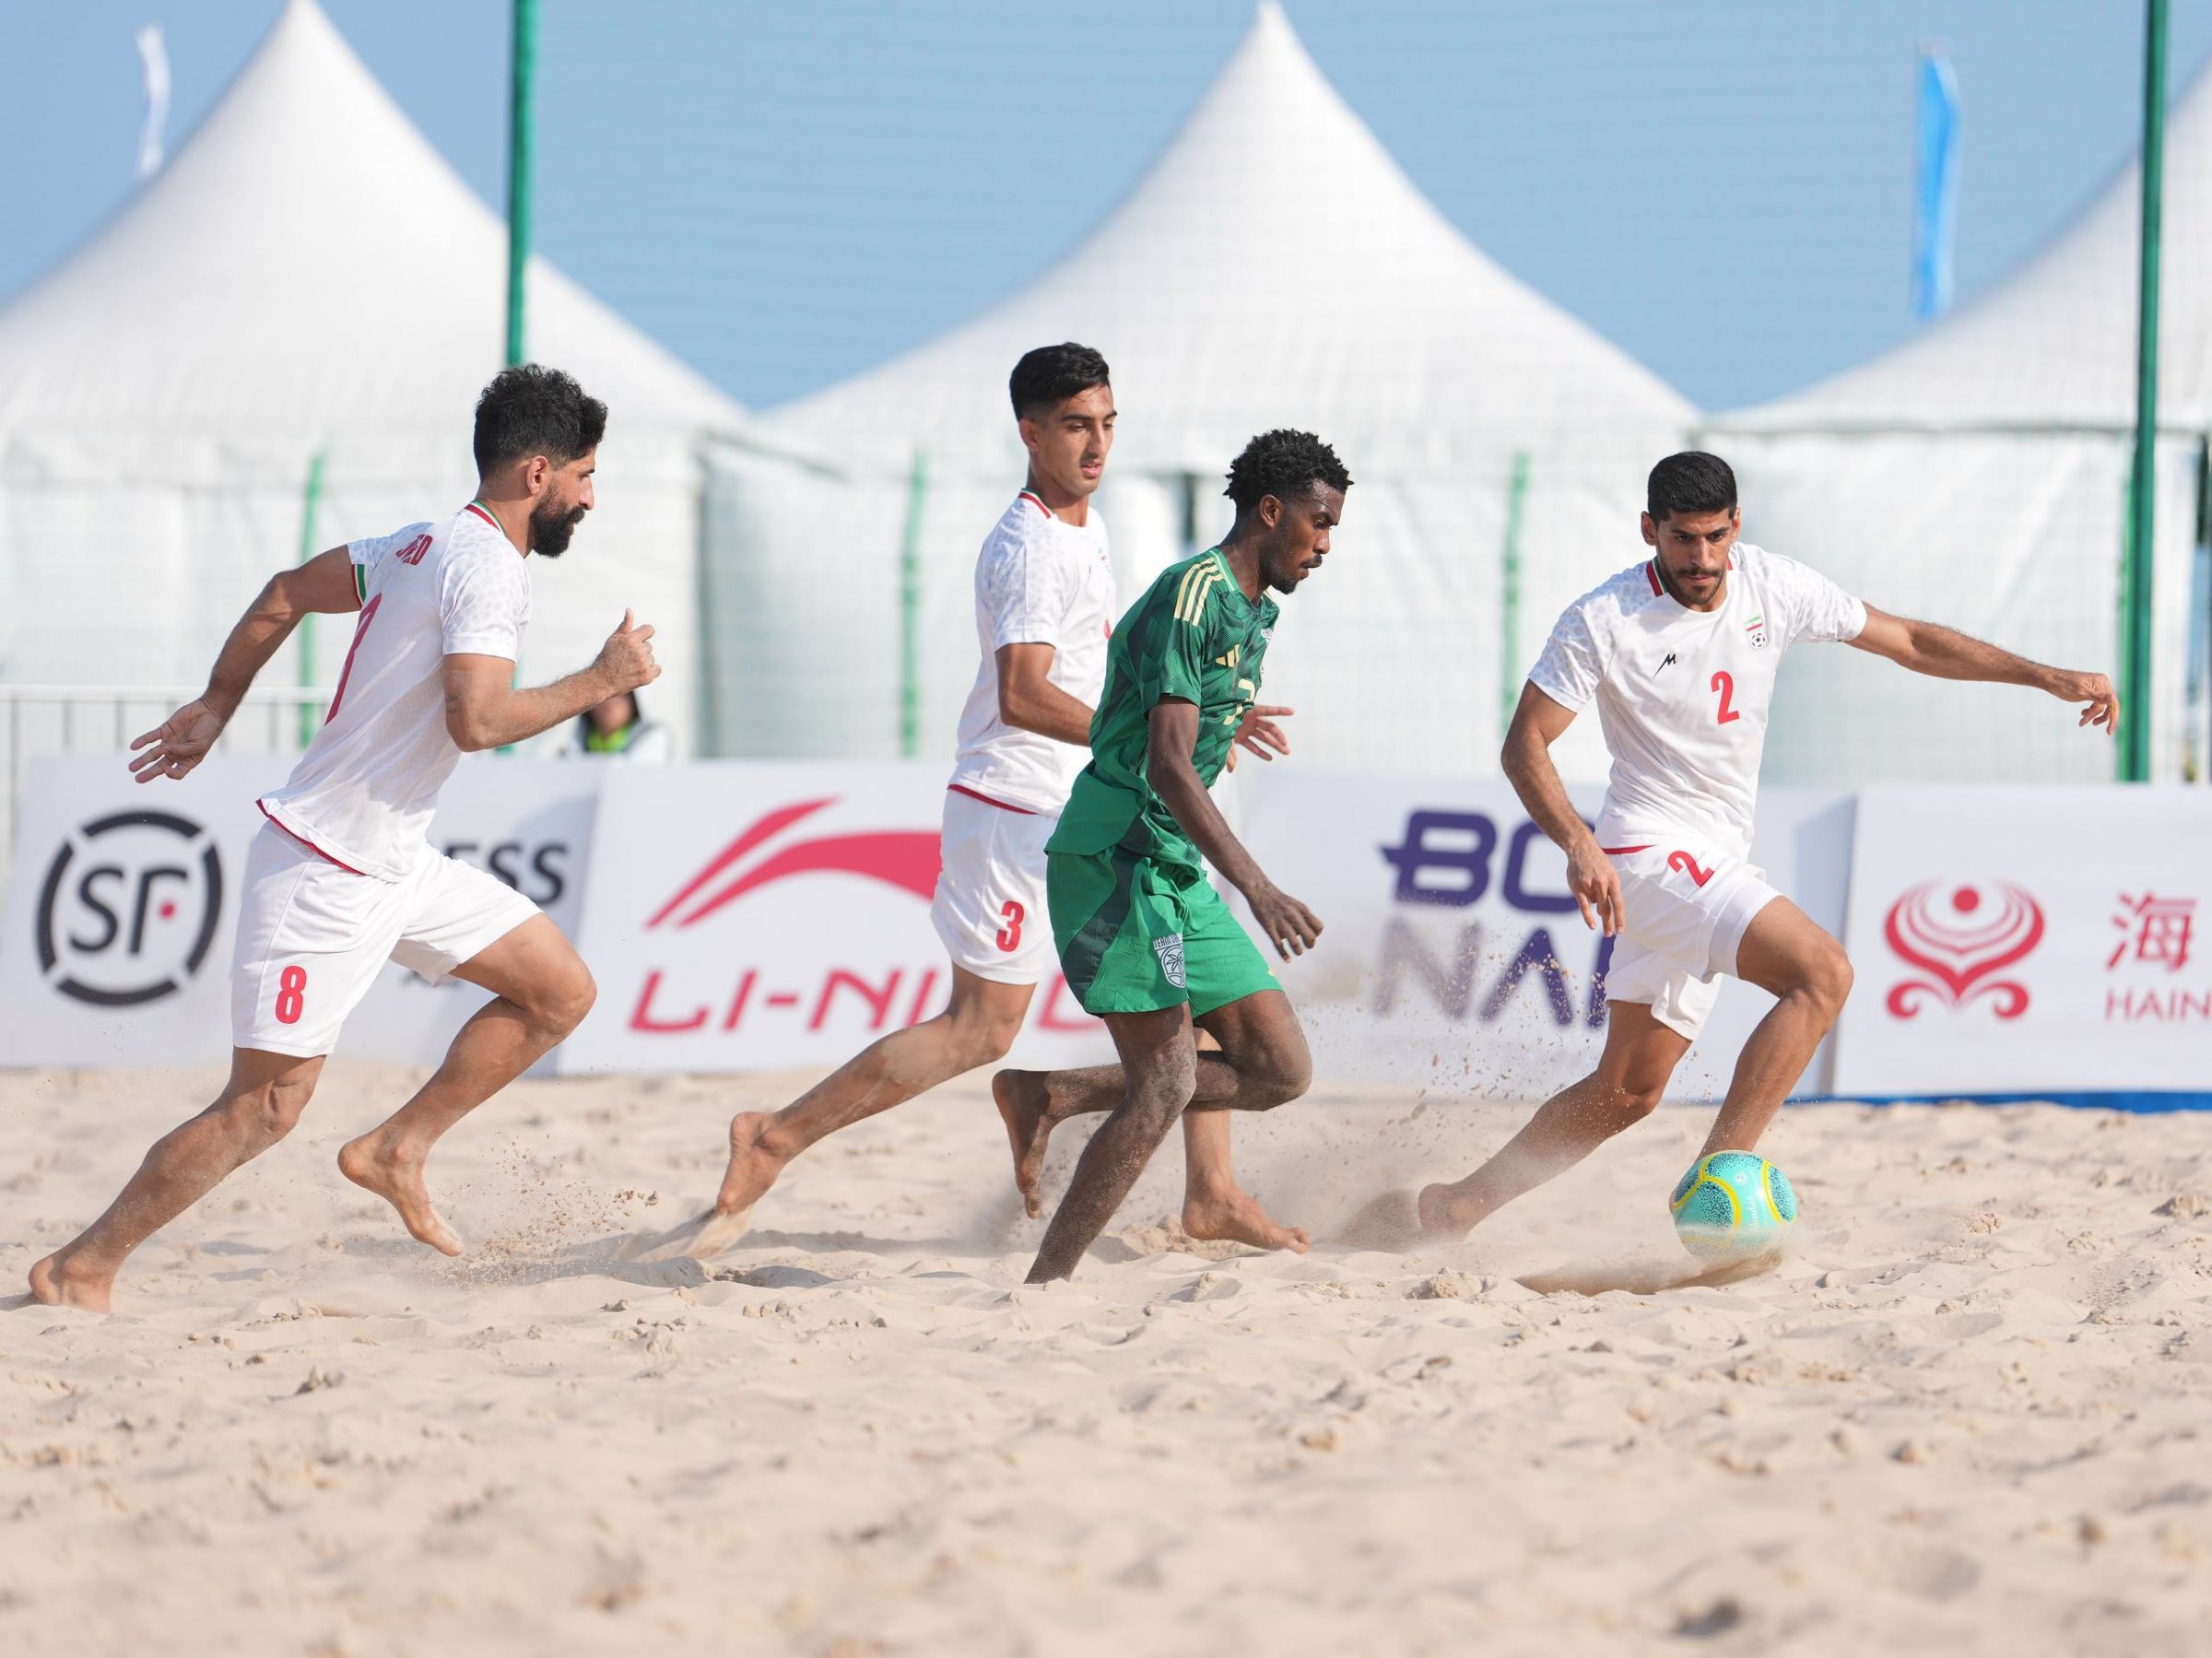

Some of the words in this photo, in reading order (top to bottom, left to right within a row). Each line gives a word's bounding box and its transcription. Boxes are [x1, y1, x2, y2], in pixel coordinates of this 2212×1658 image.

[1711, 670, 1740, 725] 2
[443, 841, 568, 905] SS
[1667, 850, 1716, 888] 2
[995, 900, 1025, 953] 3
[2107, 893, 2195, 970] 海
[275, 964, 307, 1025] 8
